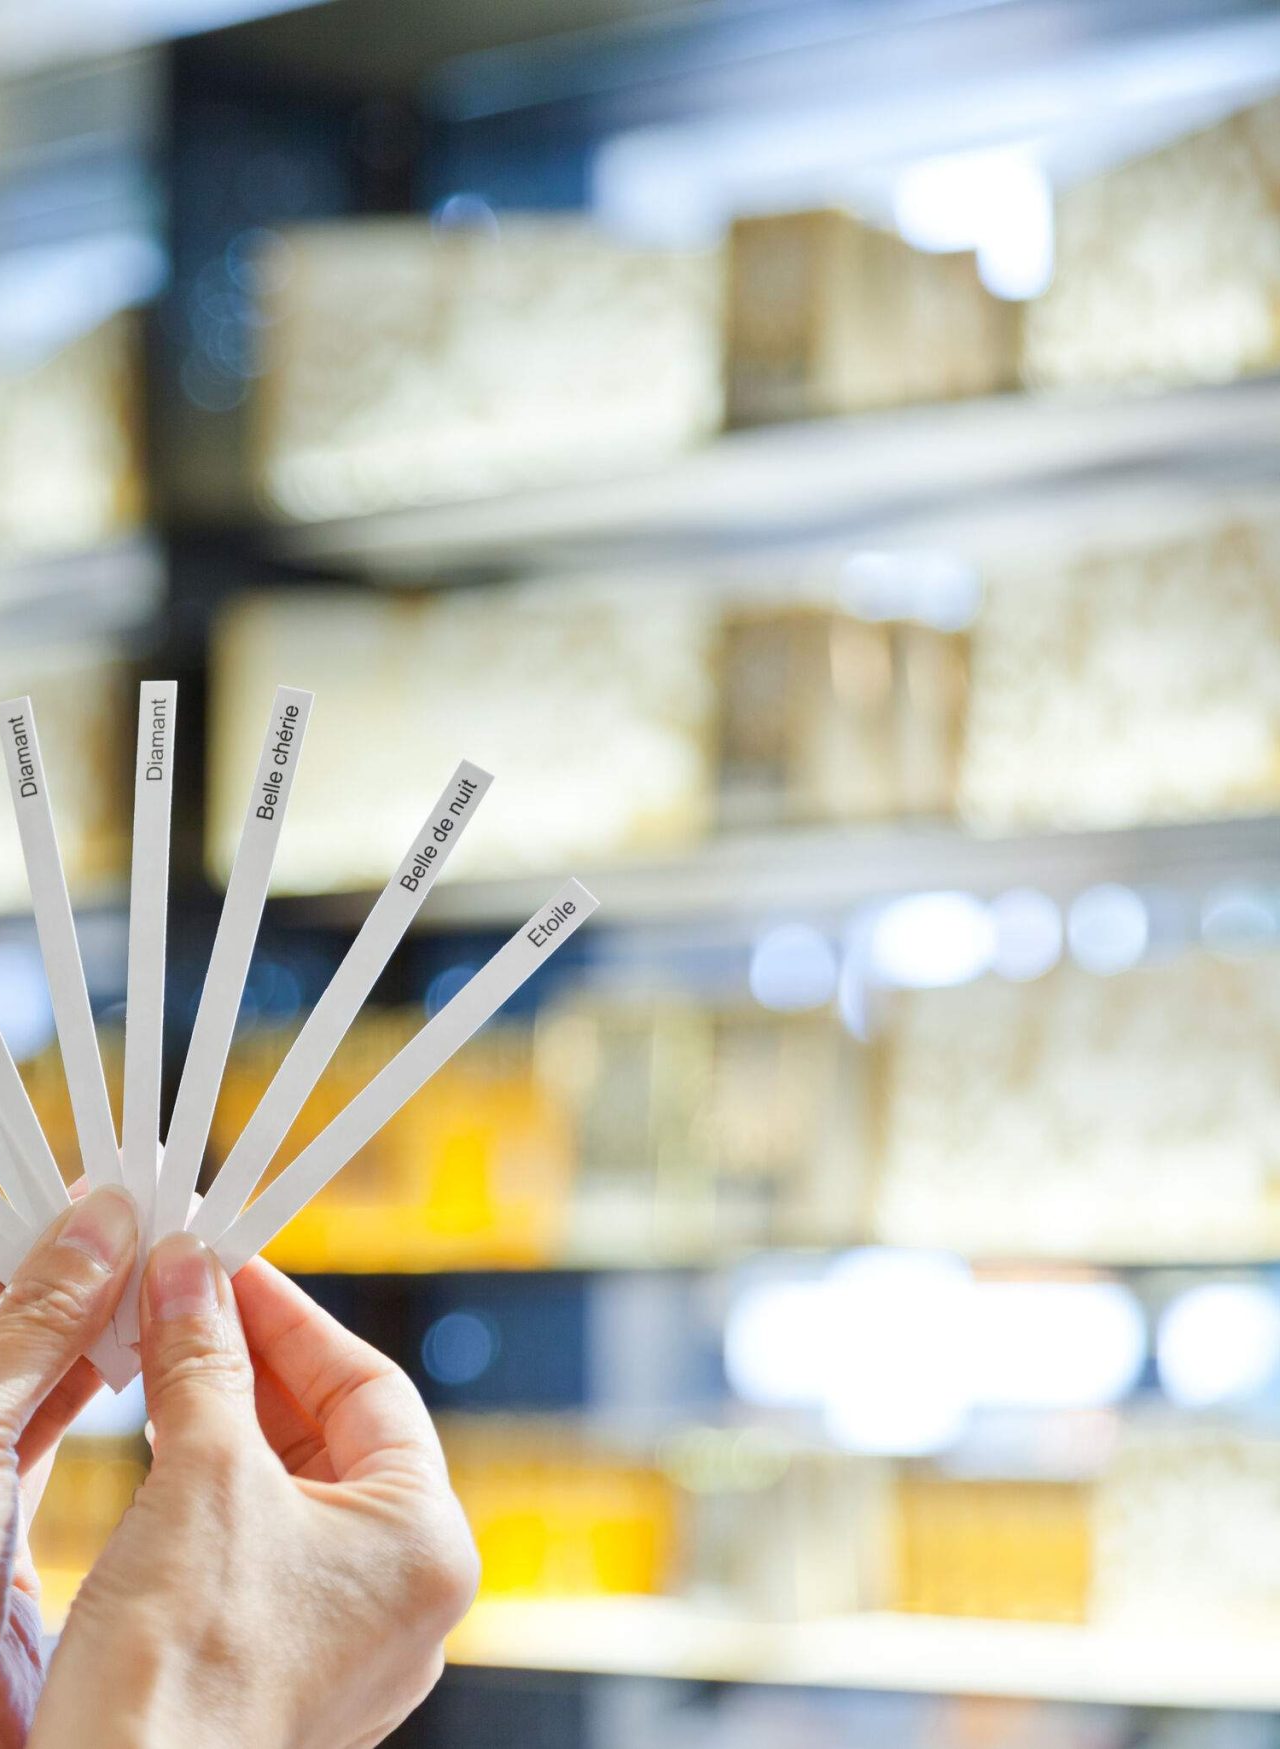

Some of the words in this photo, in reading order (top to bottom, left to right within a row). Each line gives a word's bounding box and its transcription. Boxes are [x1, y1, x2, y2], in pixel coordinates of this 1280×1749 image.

[8, 714, 38, 798] Diamant
[146, 698, 167, 781] Diamant
[256, 771, 283, 820] Belle
[272, 705, 299, 765] chérie
[399, 845, 438, 893] Belle
[432, 818, 454, 843] de
[448, 778, 478, 816] nuit
[526, 900, 577, 948] Etoile
